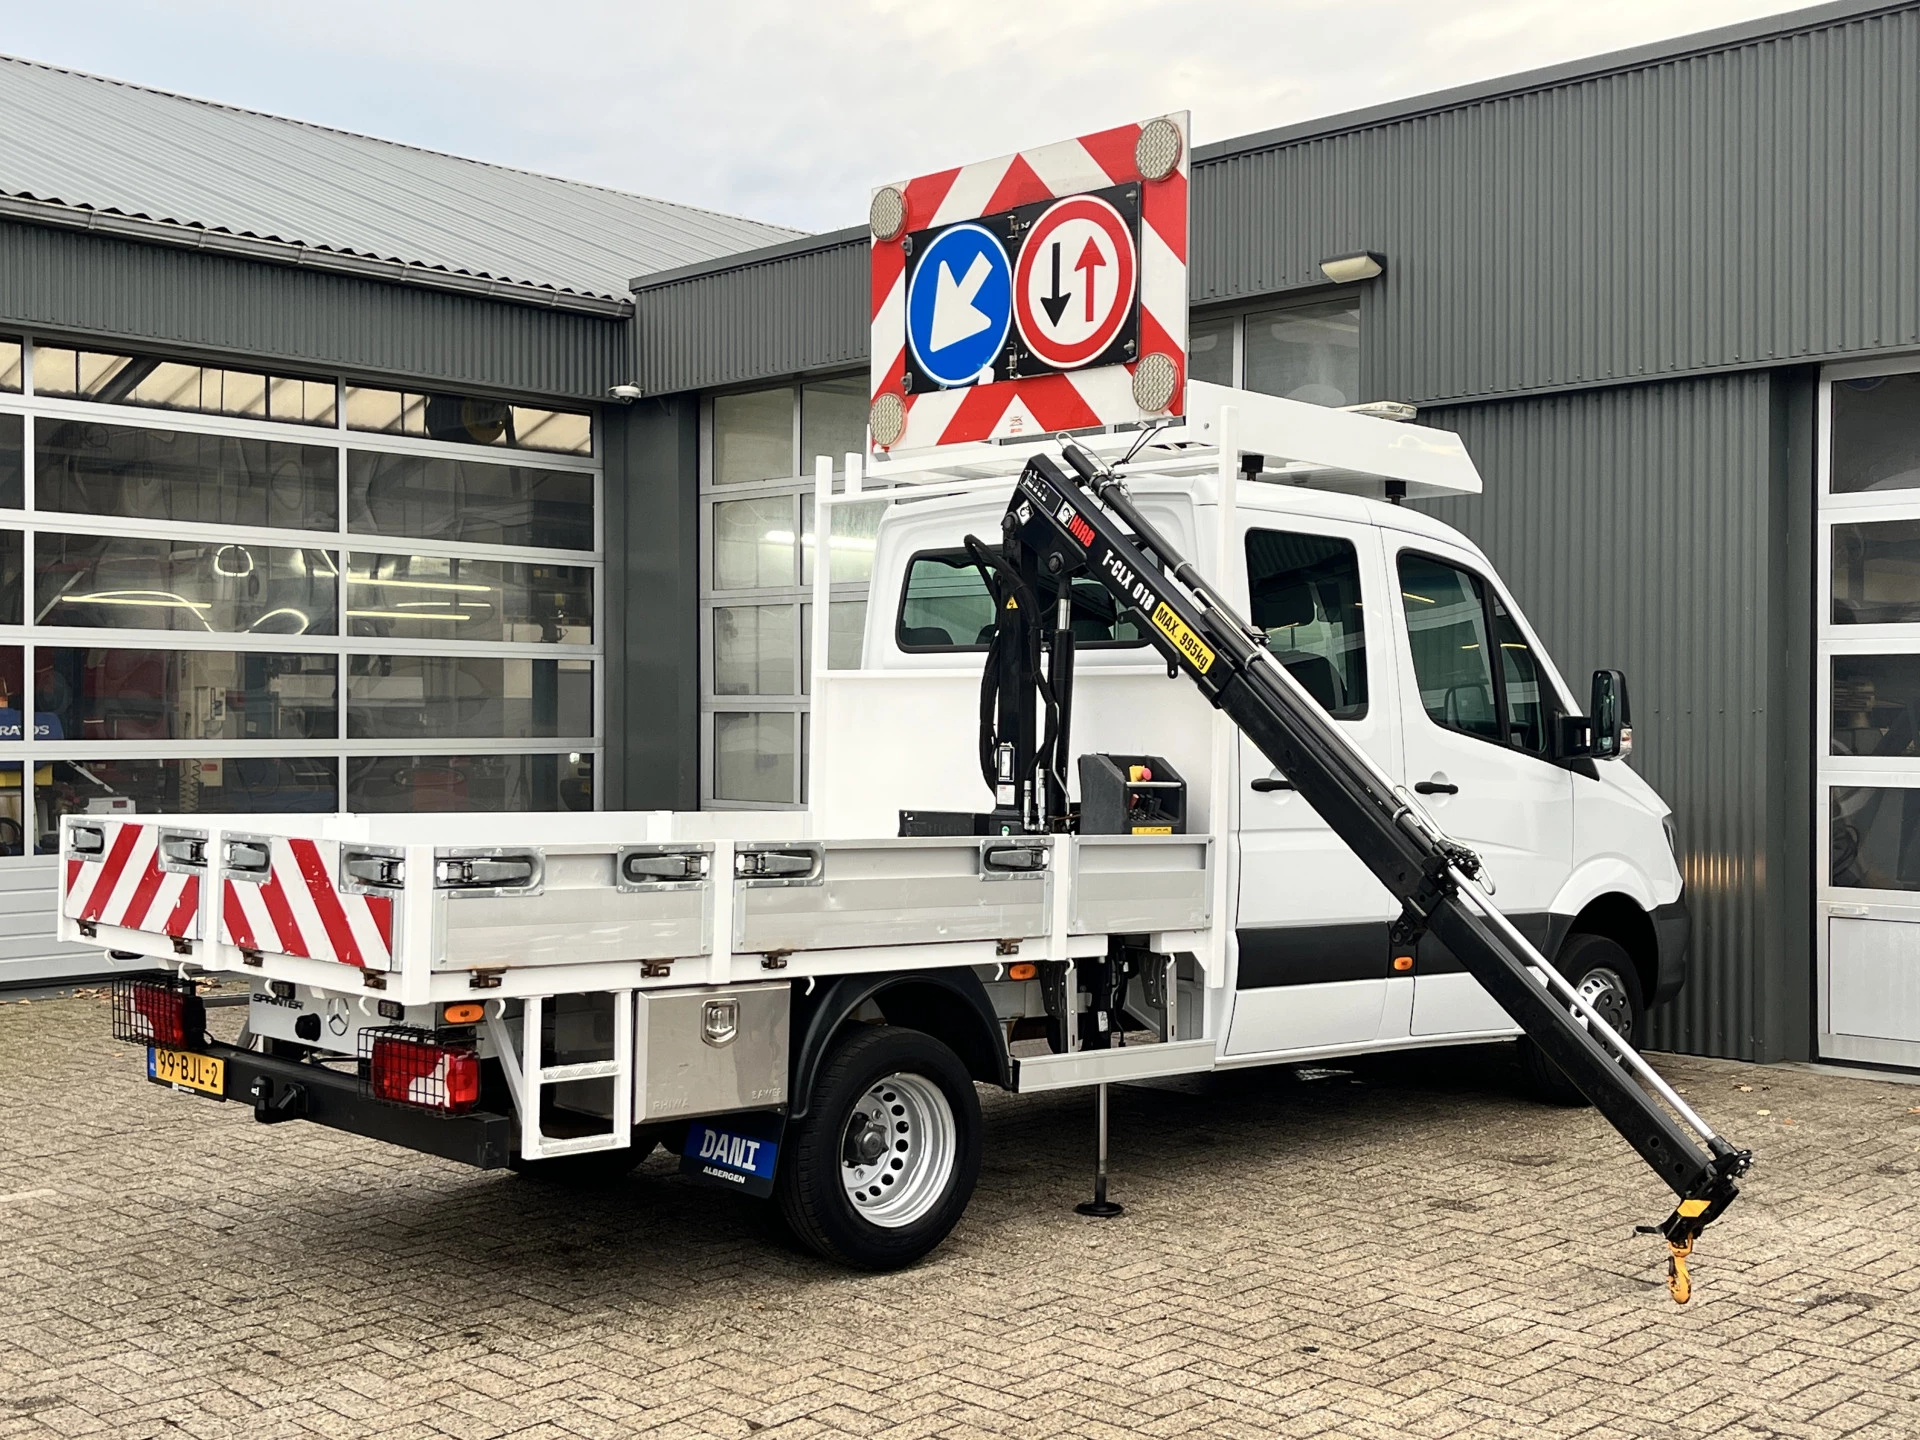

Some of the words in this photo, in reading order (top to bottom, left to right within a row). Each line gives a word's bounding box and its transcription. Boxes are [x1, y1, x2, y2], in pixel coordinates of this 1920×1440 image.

[1069, 514, 1096, 548] HIAB
[1102, 549, 1135, 590] T-CLX
[1132, 583, 1155, 611] 018
[1179, 632, 1209, 671] 995kg
[158, 1050, 218, 1088] 99-BJL-2
[699, 1129, 760, 1171] DANI
[702, 1165, 746, 1184] ALBERGEN
